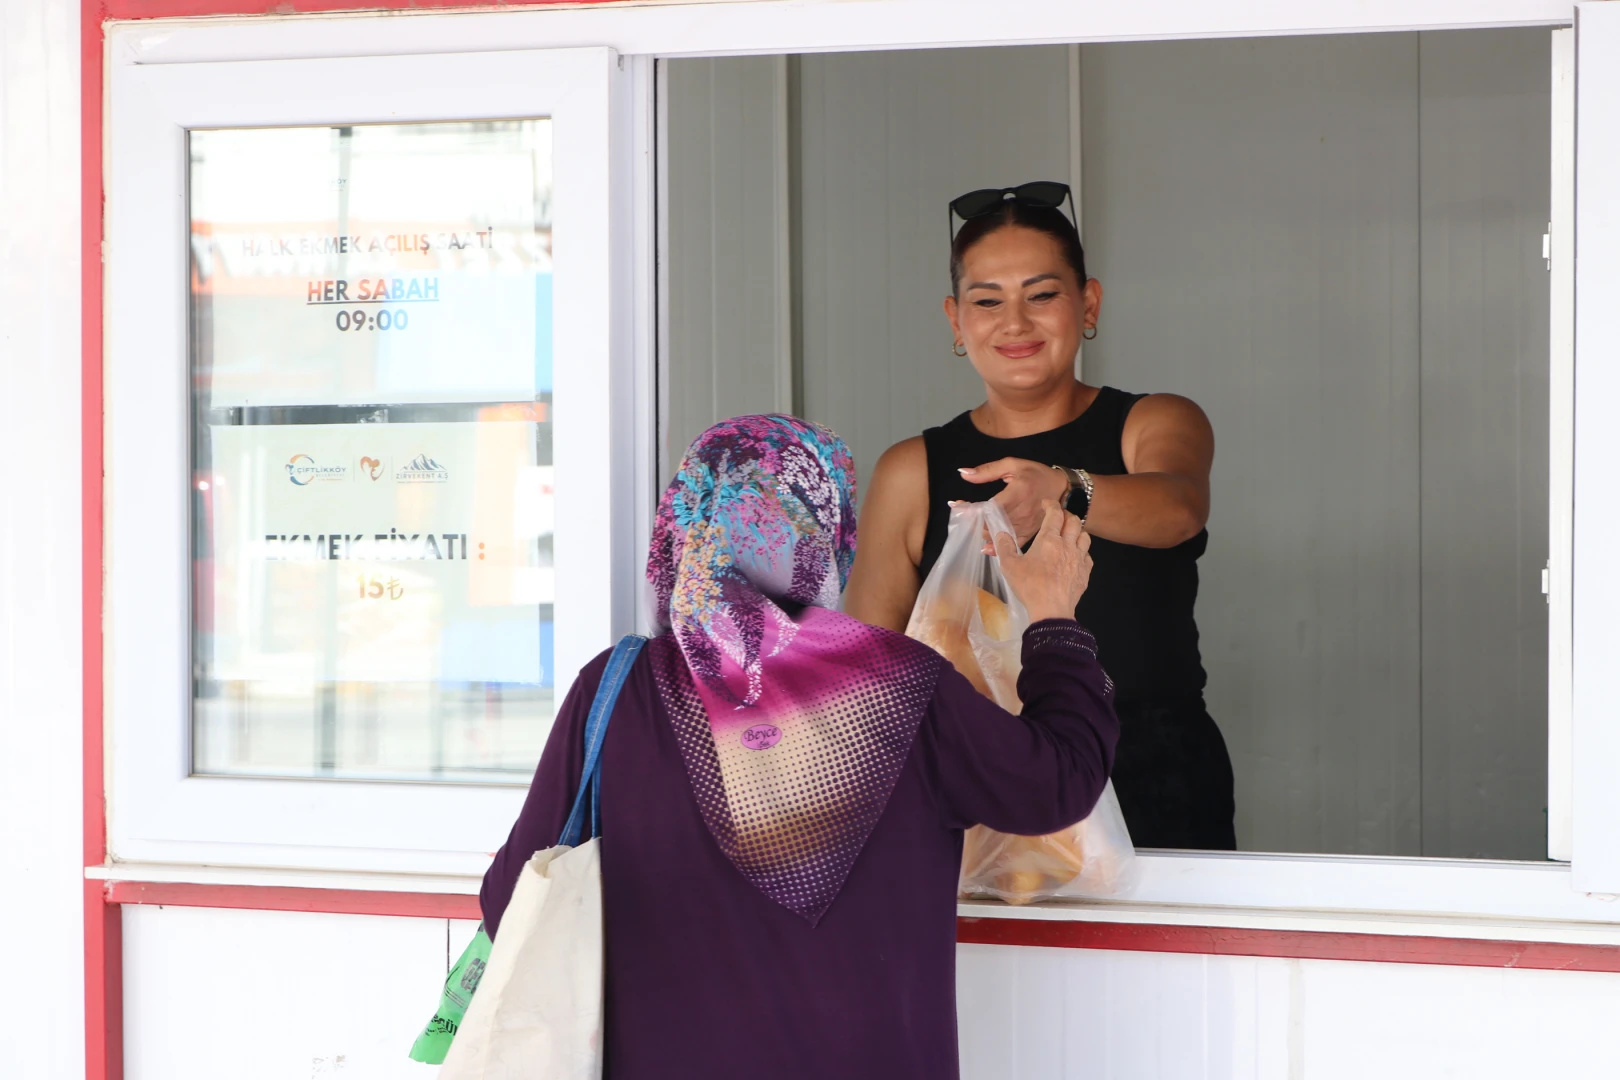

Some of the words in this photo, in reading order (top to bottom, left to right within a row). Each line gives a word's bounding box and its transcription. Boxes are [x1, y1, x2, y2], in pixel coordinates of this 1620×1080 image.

[300, 235, 361, 255] EKMEK
[367, 233, 430, 256] AÇILIŞ
[307, 279, 350, 302] HER
[356, 276, 440, 301] SABAH
[335, 309, 409, 332] 09:00
[297, 465, 347, 474] ÇİFTLİKKÖY
[744, 727, 777, 741] Beyce
